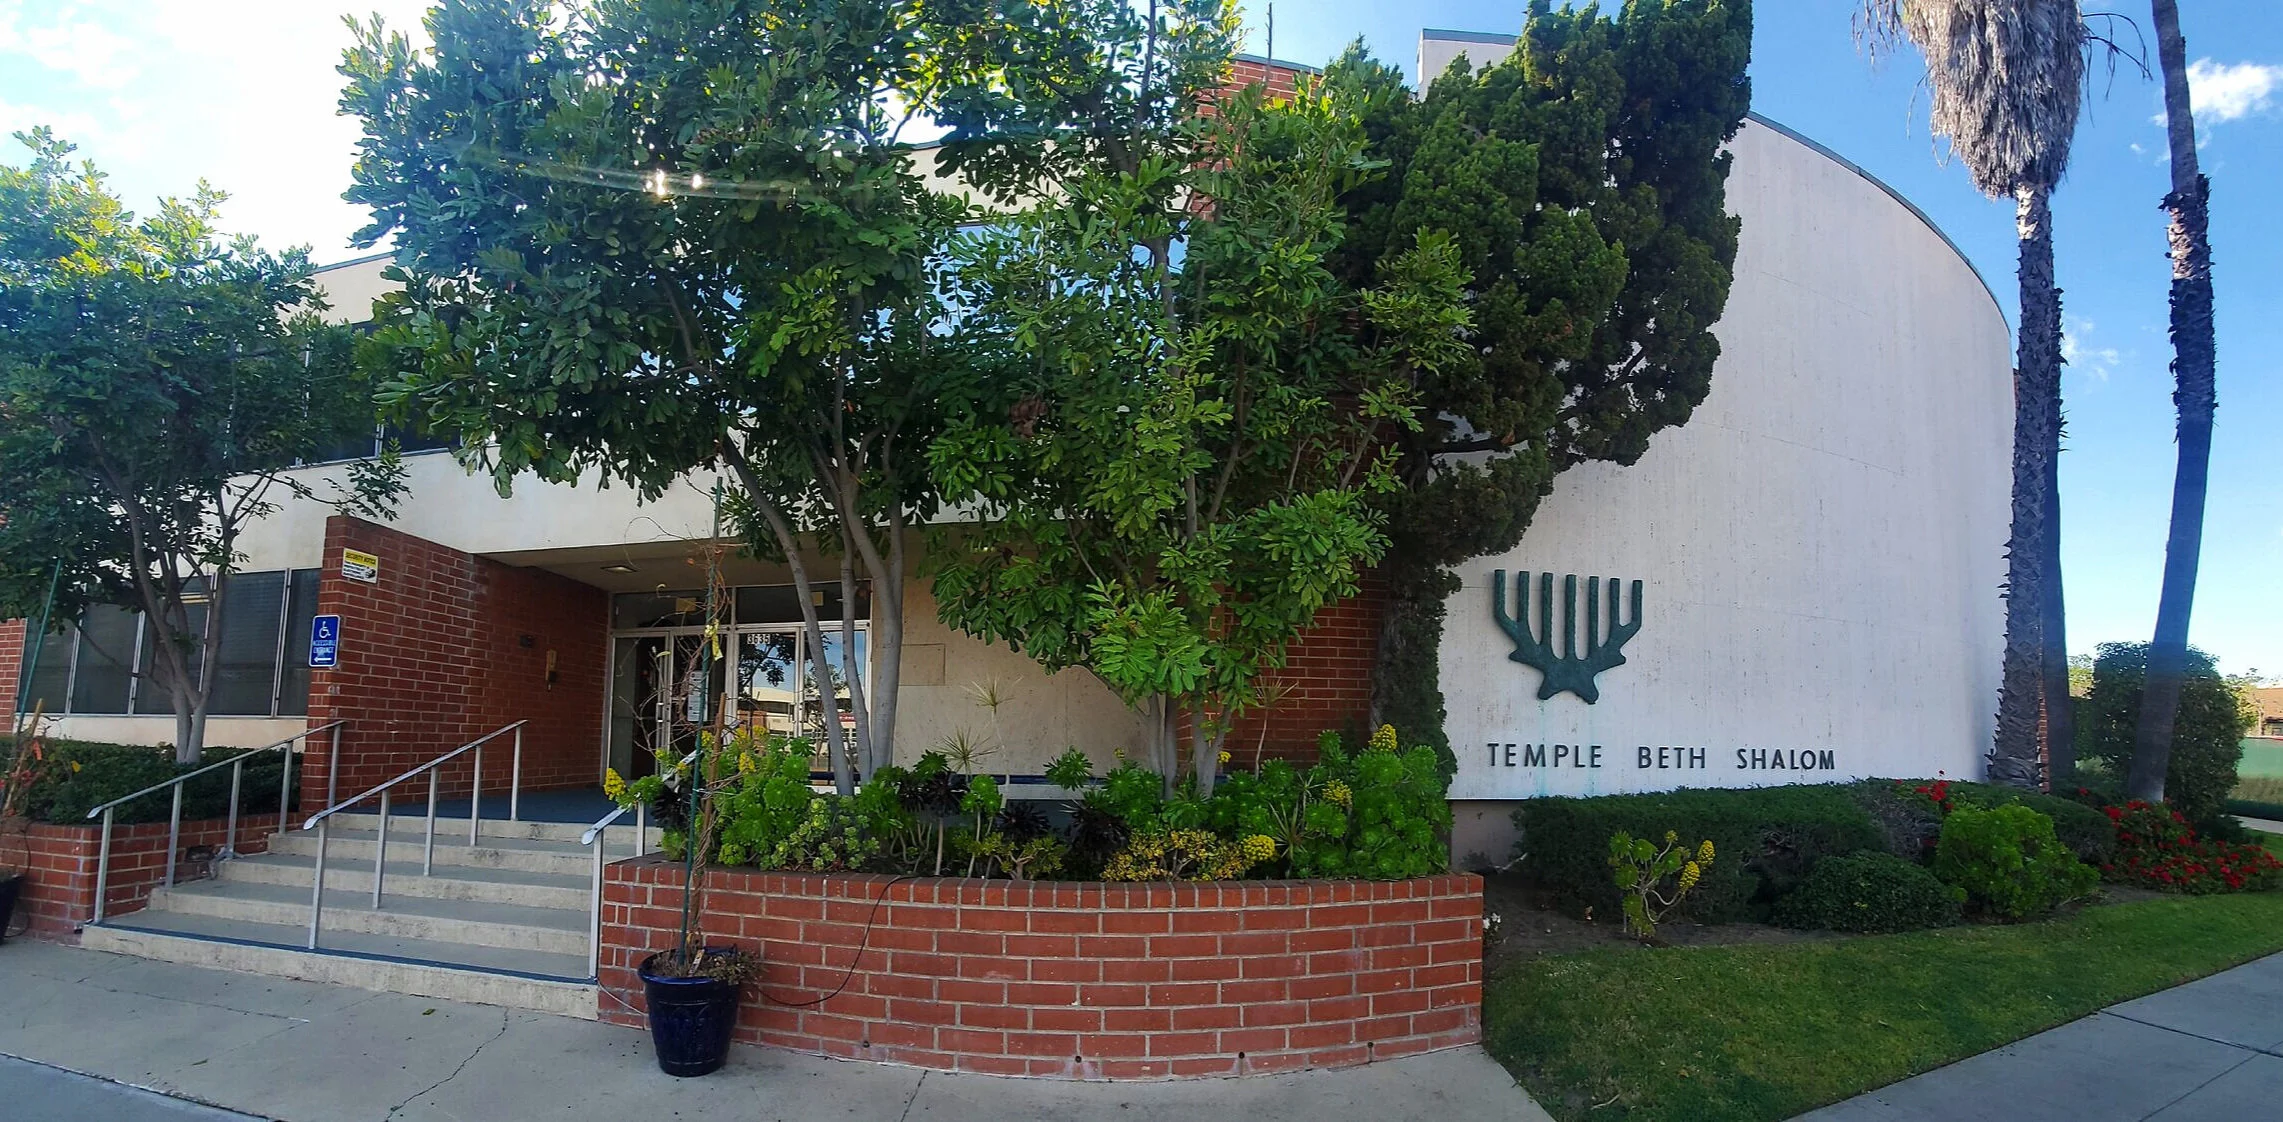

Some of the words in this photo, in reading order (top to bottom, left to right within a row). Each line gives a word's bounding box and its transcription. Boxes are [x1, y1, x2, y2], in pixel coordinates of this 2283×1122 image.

[747, 634, 769, 644] 3635
[1487, 743, 1603, 768] TEMPLE
[1637, 746, 1707, 769] BETH
[1736, 748, 1836, 770] SHALOM
